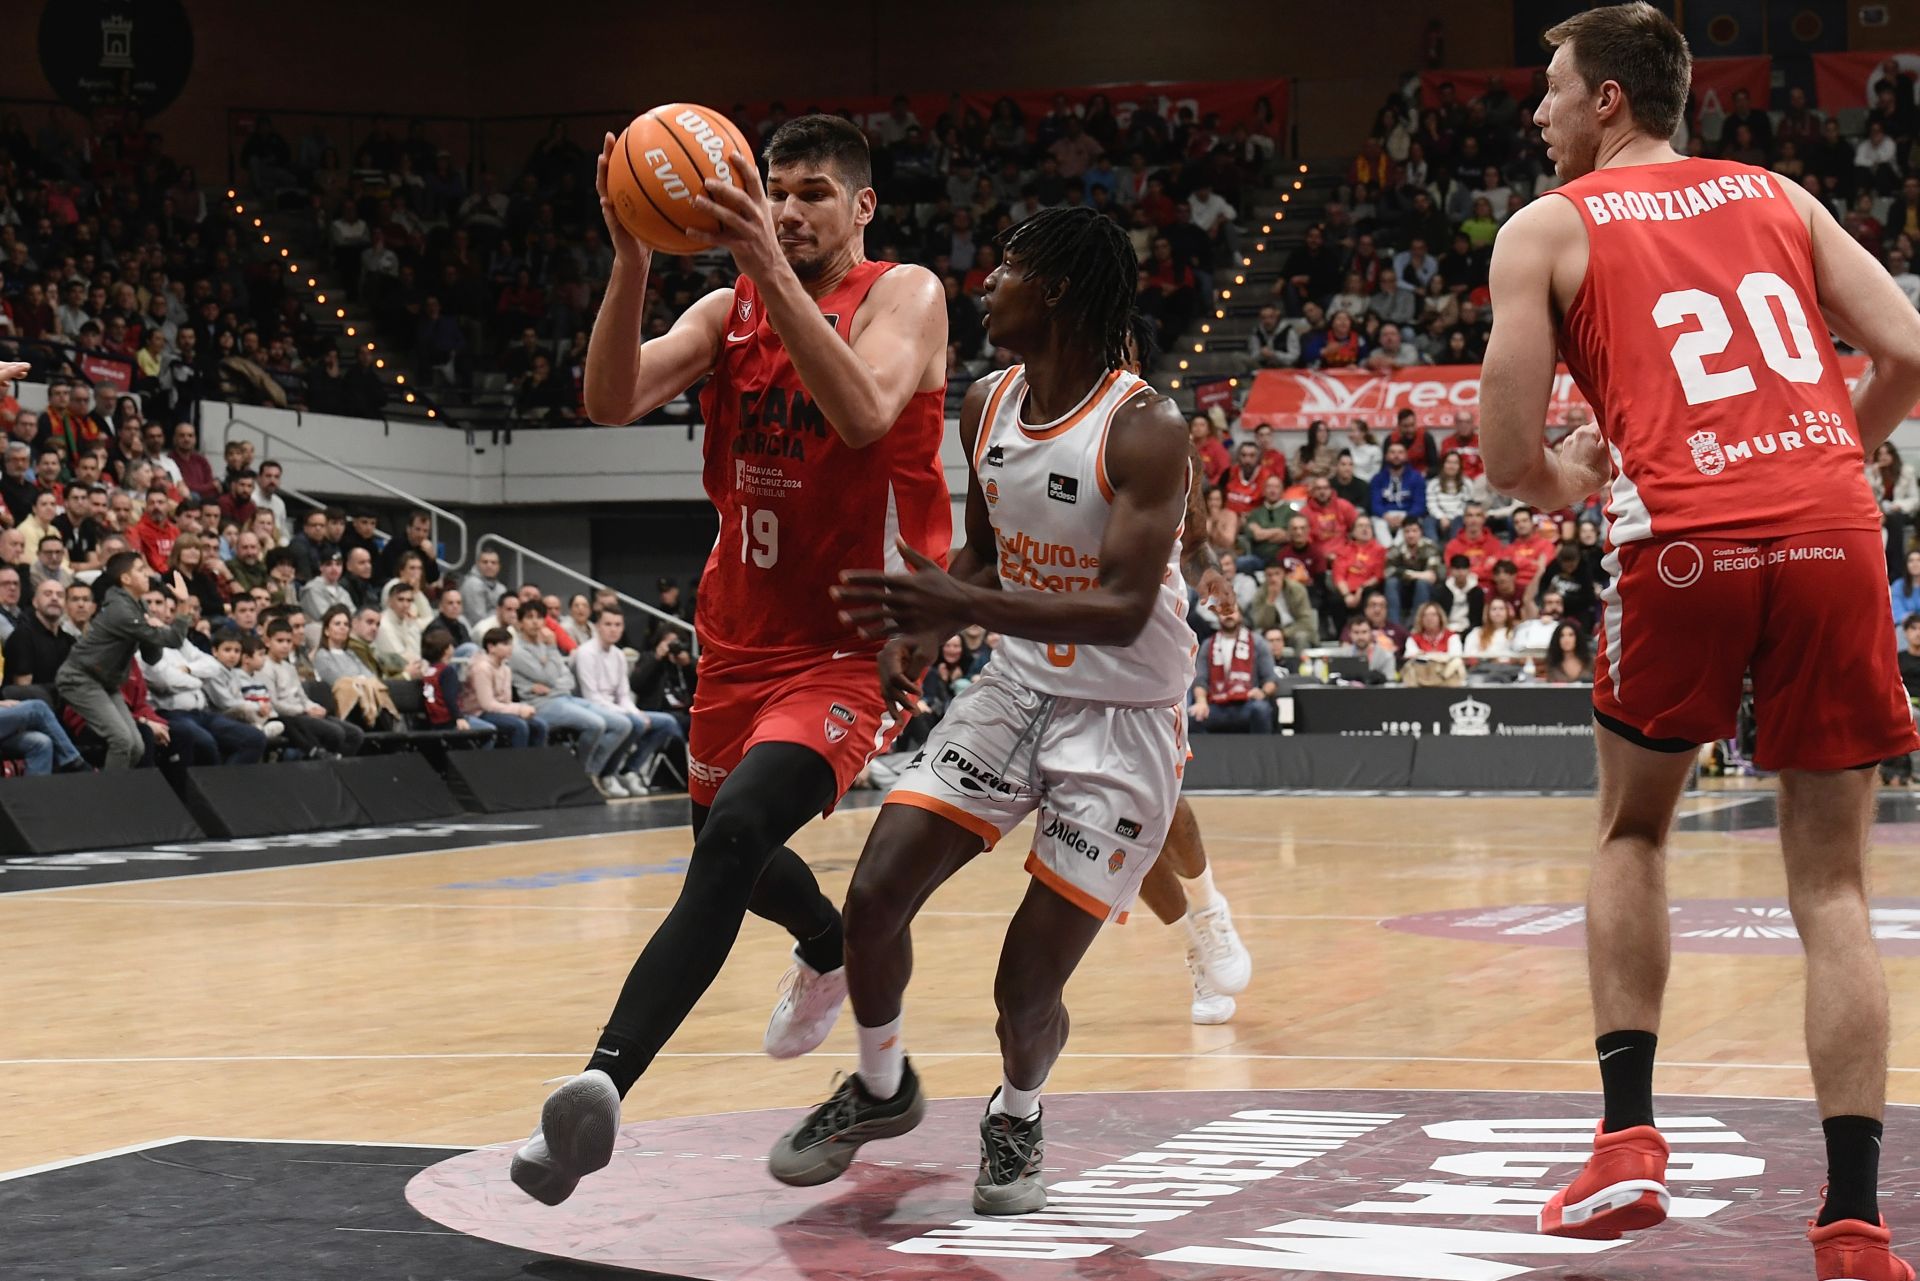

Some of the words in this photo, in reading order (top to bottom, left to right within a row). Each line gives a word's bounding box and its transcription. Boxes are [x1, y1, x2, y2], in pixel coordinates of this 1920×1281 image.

[1583, 174, 1776, 226] BRODZIANSKY
[1651, 272, 1824, 406] 20
[1788, 410, 1842, 427] 1200
[1724, 424, 1856, 463] MURCIA
[746, 465, 783, 477] CARAVACA
[752, 477, 760, 485] LA
[761, 478, 781, 487] CRUZ
[782, 480, 802, 489] 2024
[756, 488, 787, 498] JUBILAR
[741, 505, 779, 569] 19
[1768, 550, 1786, 564] DE
[1789, 547, 1846, 561] MURCIA
[941, 750, 1011, 795] PULEVA
[1045, 816, 1099, 861] Midea
[1118, 824, 1134, 837] acb
